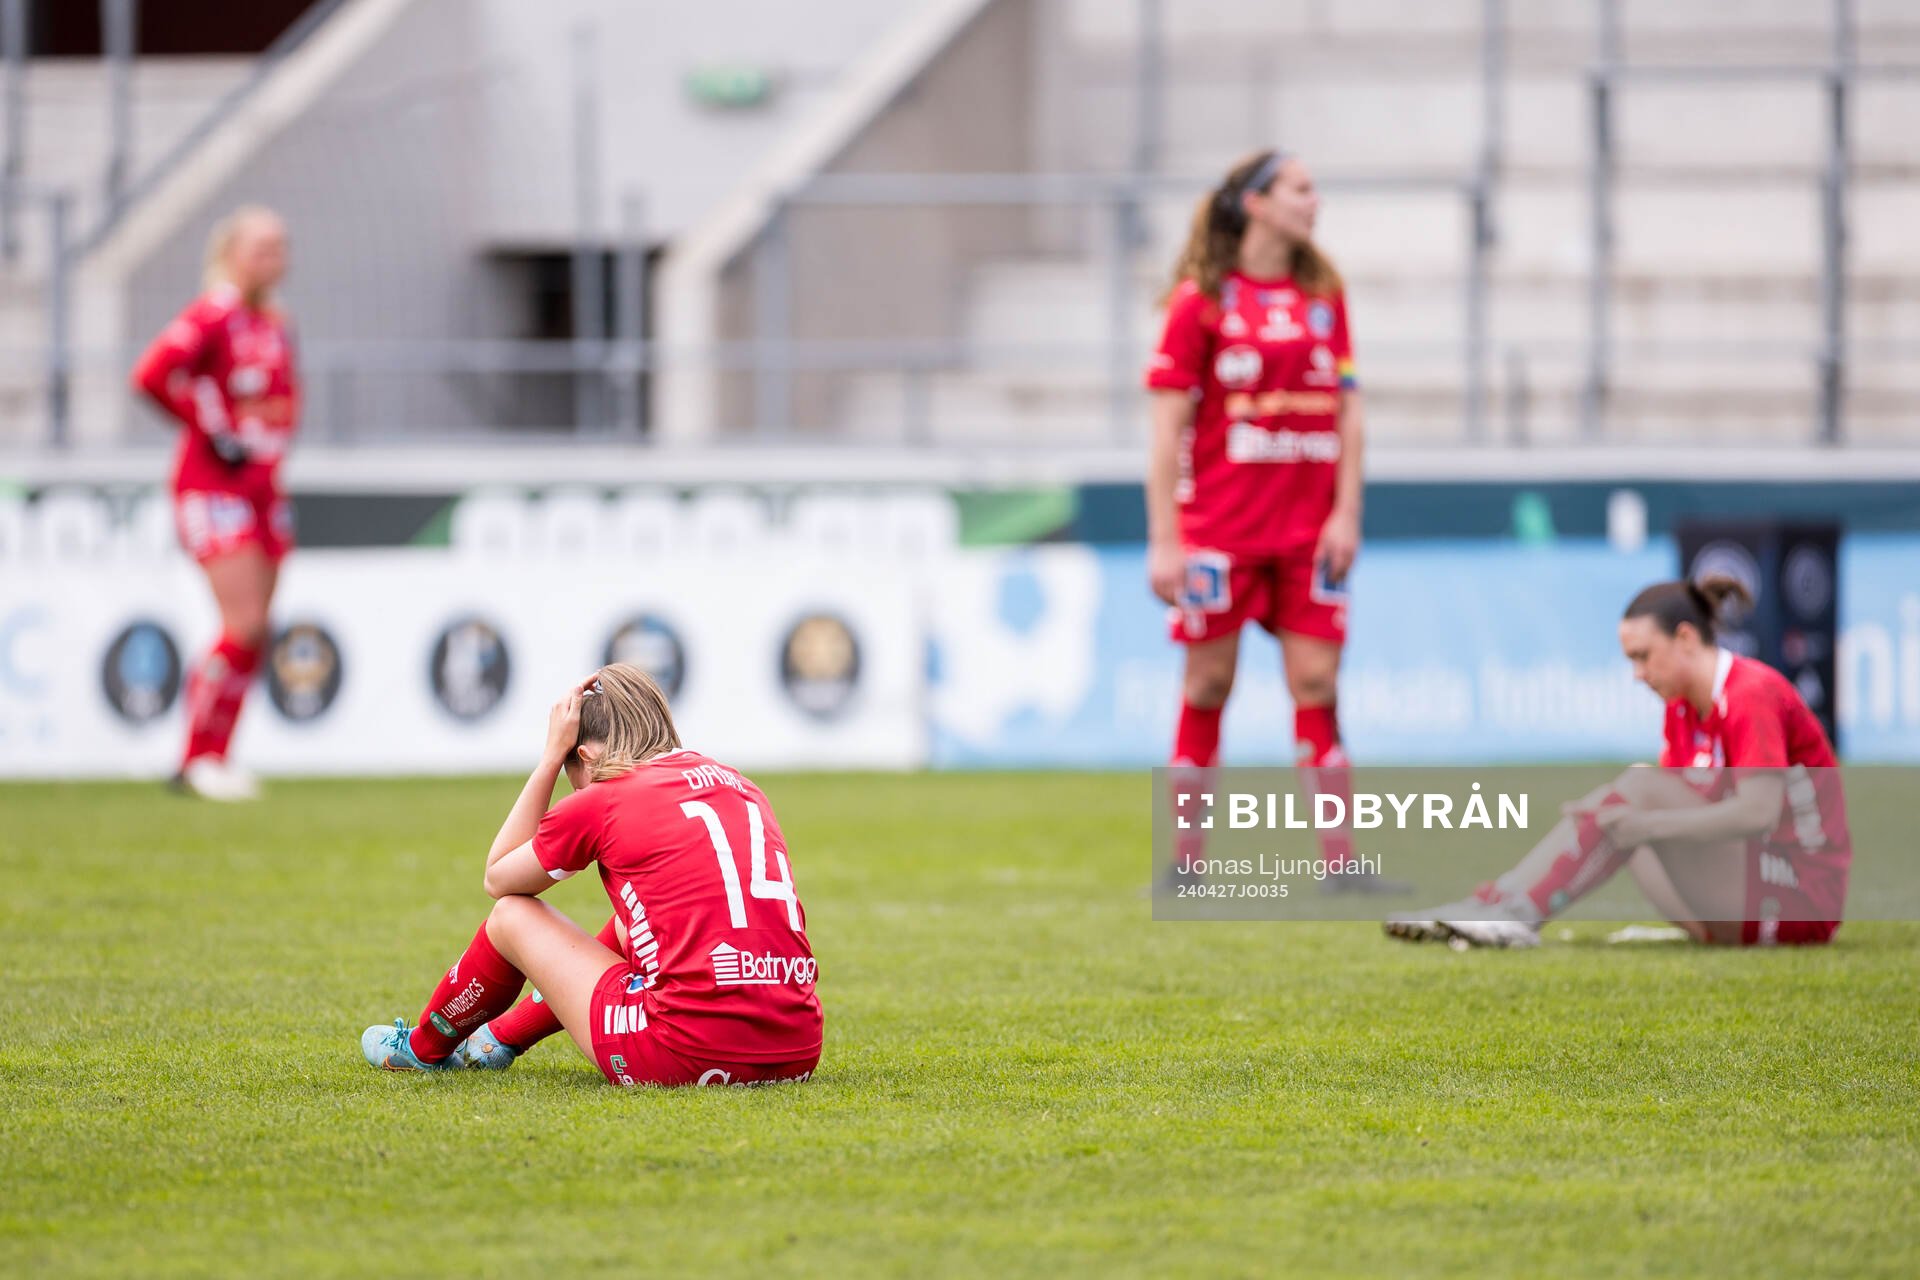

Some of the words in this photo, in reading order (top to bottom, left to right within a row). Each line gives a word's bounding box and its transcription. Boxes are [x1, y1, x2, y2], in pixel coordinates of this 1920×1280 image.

[679, 800, 802, 932] 14
[741, 950, 816, 985] Botrygg
[441, 977, 485, 1019] LUNDBERGS
